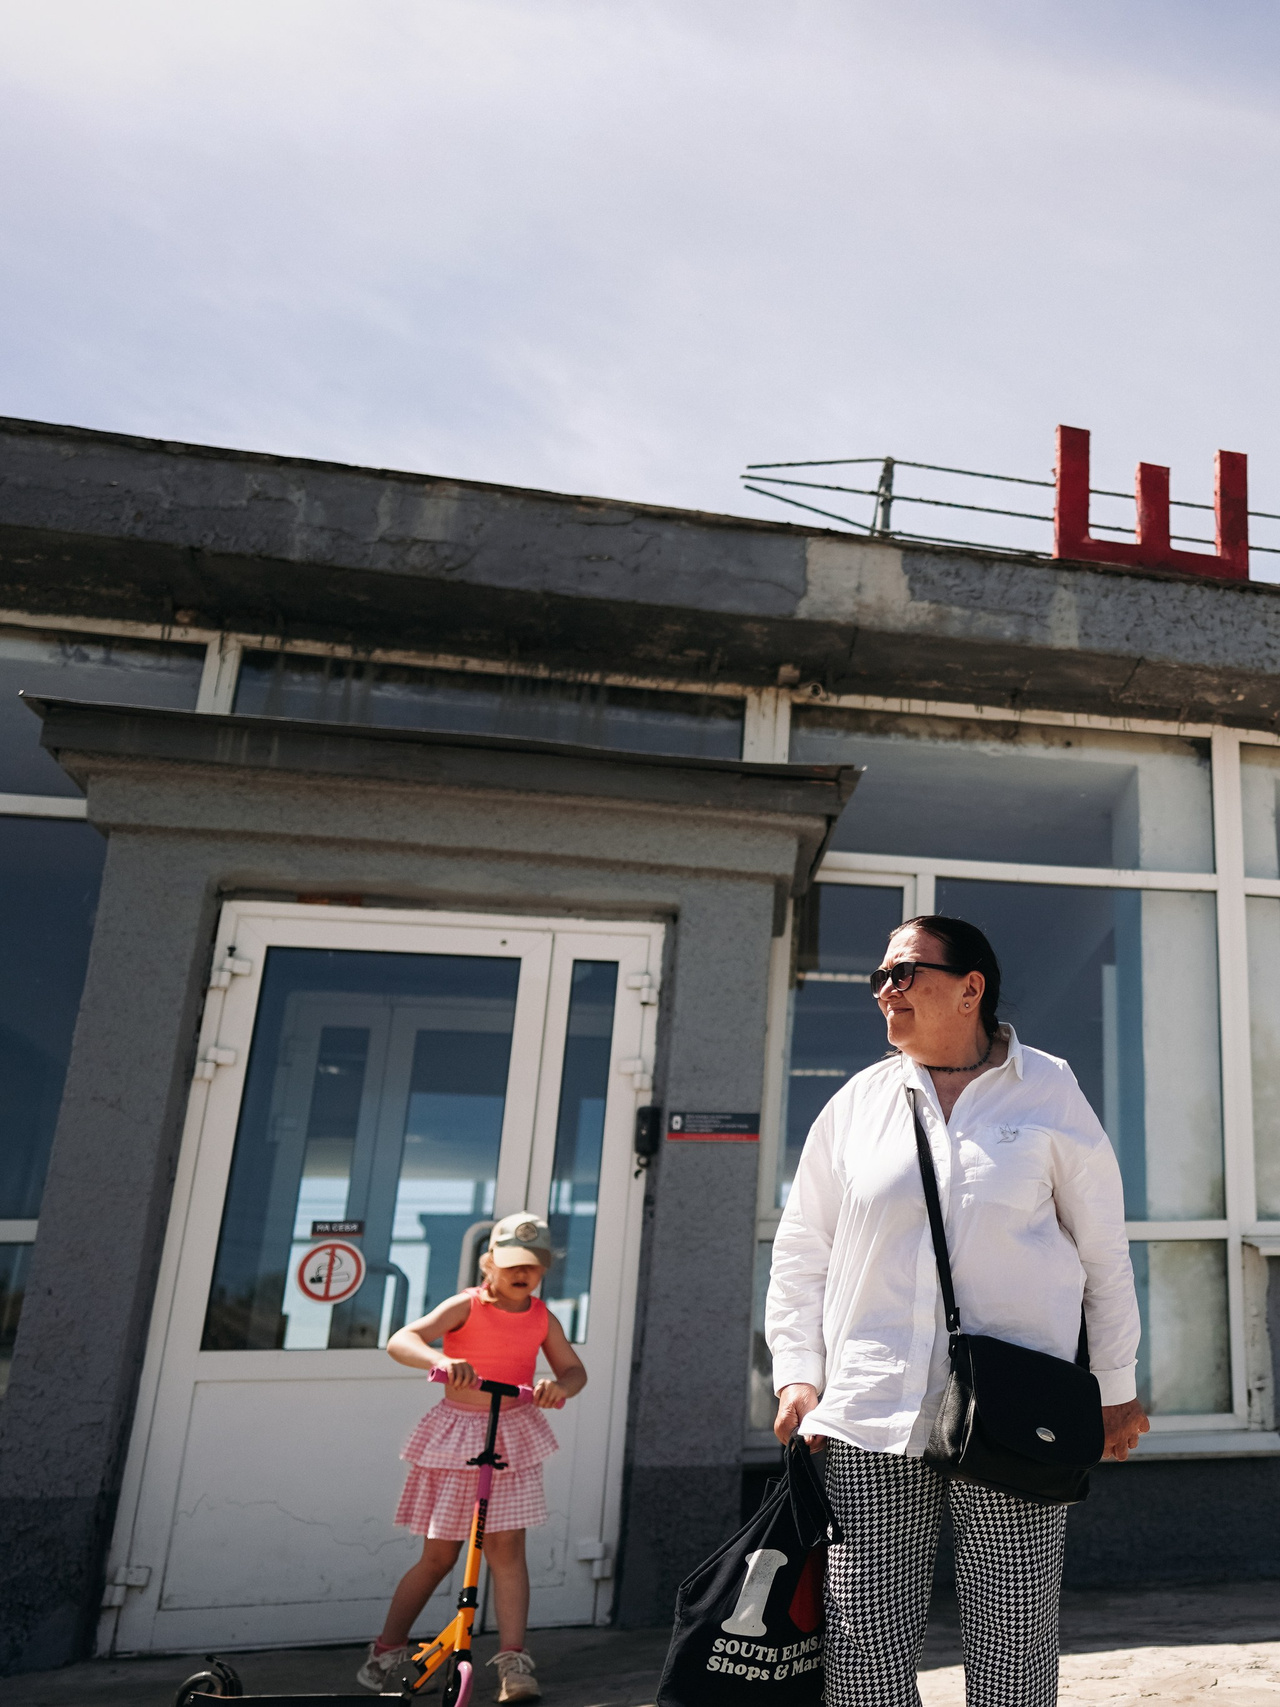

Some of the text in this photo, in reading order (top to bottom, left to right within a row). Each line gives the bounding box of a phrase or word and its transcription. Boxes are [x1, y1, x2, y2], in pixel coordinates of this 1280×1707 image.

[316, 1223, 330, 1232] НА
[712, 1638, 778, 1663] SOUTH
[706, 1655, 770, 1681] Shops
[773, 1664, 789, 1680] &
